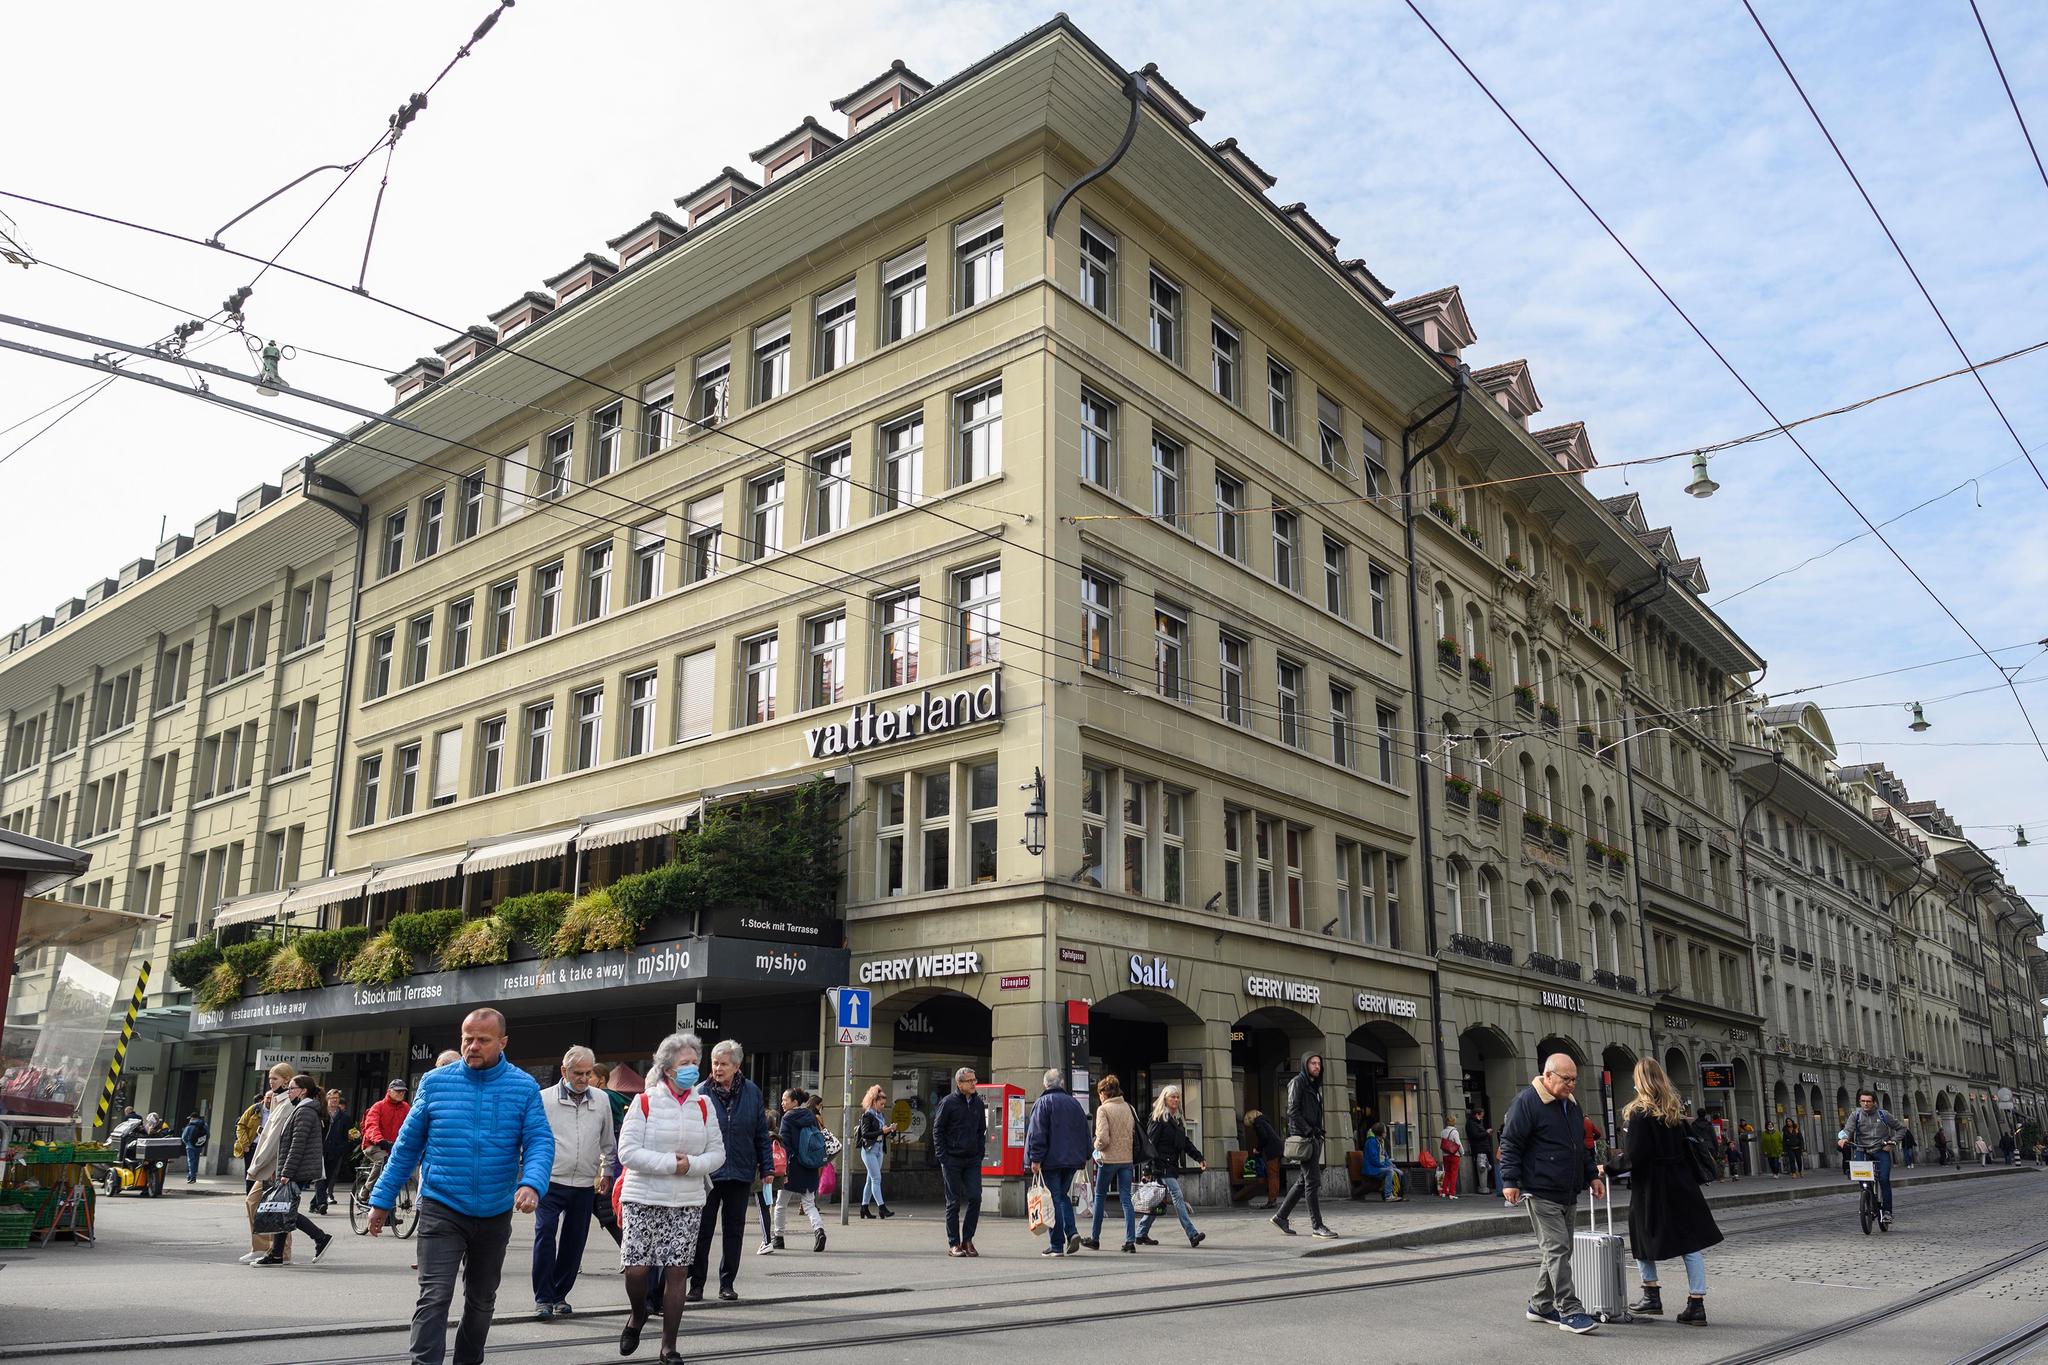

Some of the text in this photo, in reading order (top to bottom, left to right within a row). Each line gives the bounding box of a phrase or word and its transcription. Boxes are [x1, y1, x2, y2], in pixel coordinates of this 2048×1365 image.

[803, 671, 1000, 759] vatterland
[772, 922, 785, 931] mit
[786, 923, 819, 935] Terrasse
[1062, 949, 1085, 961] Spitalgasse
[504, 963, 625, 989] restaurant & take away
[859, 951, 979, 984] GERRY WEBER
[1130, 954, 1175, 989] Salt.
[387, 987, 402, 1002] mit
[404, 984, 442, 1000] Terrasse
[1247, 976, 1321, 1005] GERRY WEBER
[1357, 993, 1417, 1018] GERRY WEBER
[1542, 991, 1568, 1009] BAYARD
[231, 1006, 264, 1020] restaurant
[265, 1004, 271, 1016] &
[272, 1003, 287, 1016] take
[289, 1002, 307, 1015] away
[677, 1019, 694, 1030] Salt.
[696, 1018, 719, 1029] Salt.
[899, 1012, 934, 1033] Salt.
[264, 1054, 295, 1063] vatter
[411, 1043, 433, 1060] Salt.
